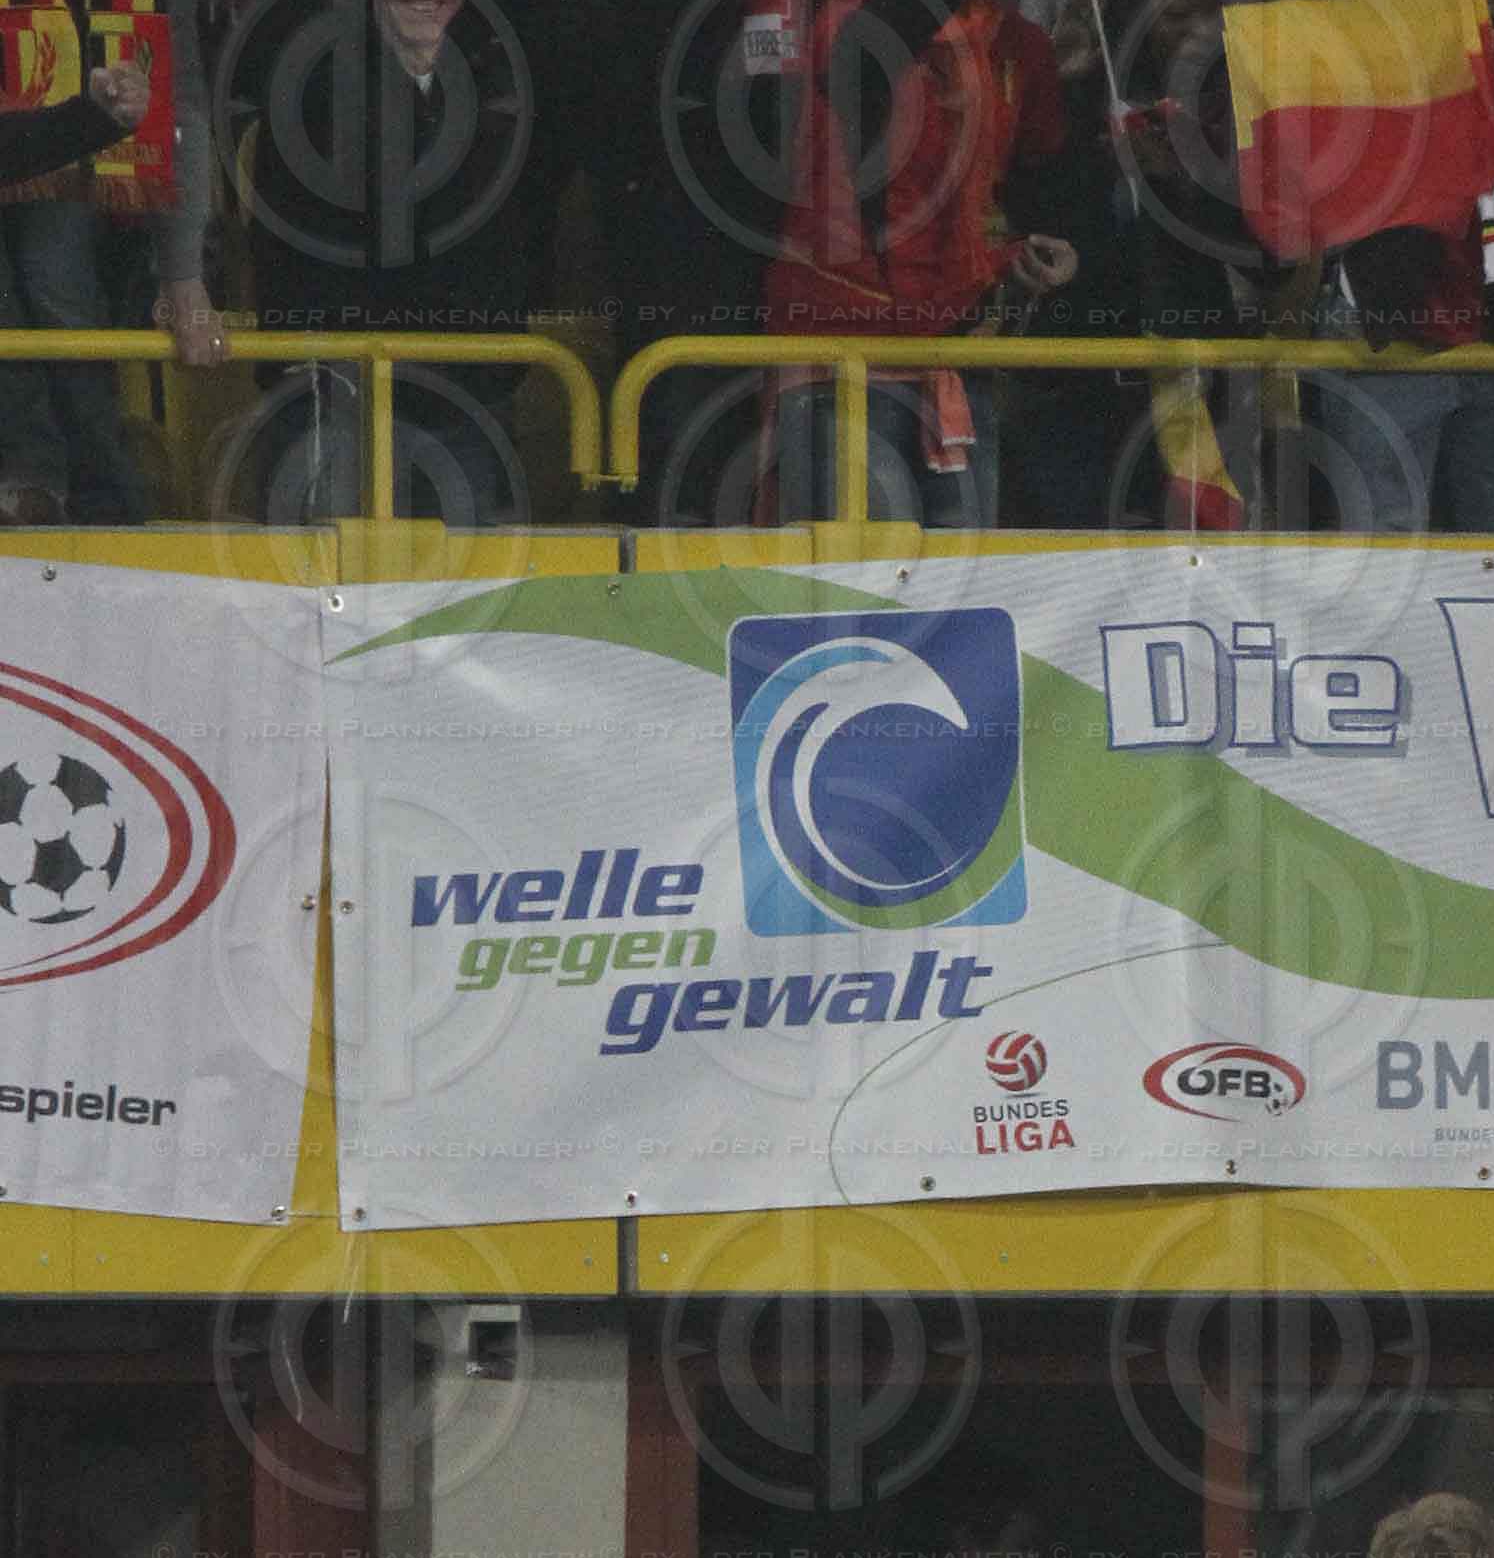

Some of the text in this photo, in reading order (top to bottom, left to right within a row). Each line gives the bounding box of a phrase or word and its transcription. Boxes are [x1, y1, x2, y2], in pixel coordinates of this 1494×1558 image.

[1099, 620, 1402, 751] Die
[411, 848, 705, 927] welle
[455, 928, 717, 992] gegen
[599, 949, 993, 1057] gewalt
[0, 1080, 177, 1126] spieler
[973, 1098, 1070, 1123] BUNDES
[975, 1119, 1076, 1155] LIGA
